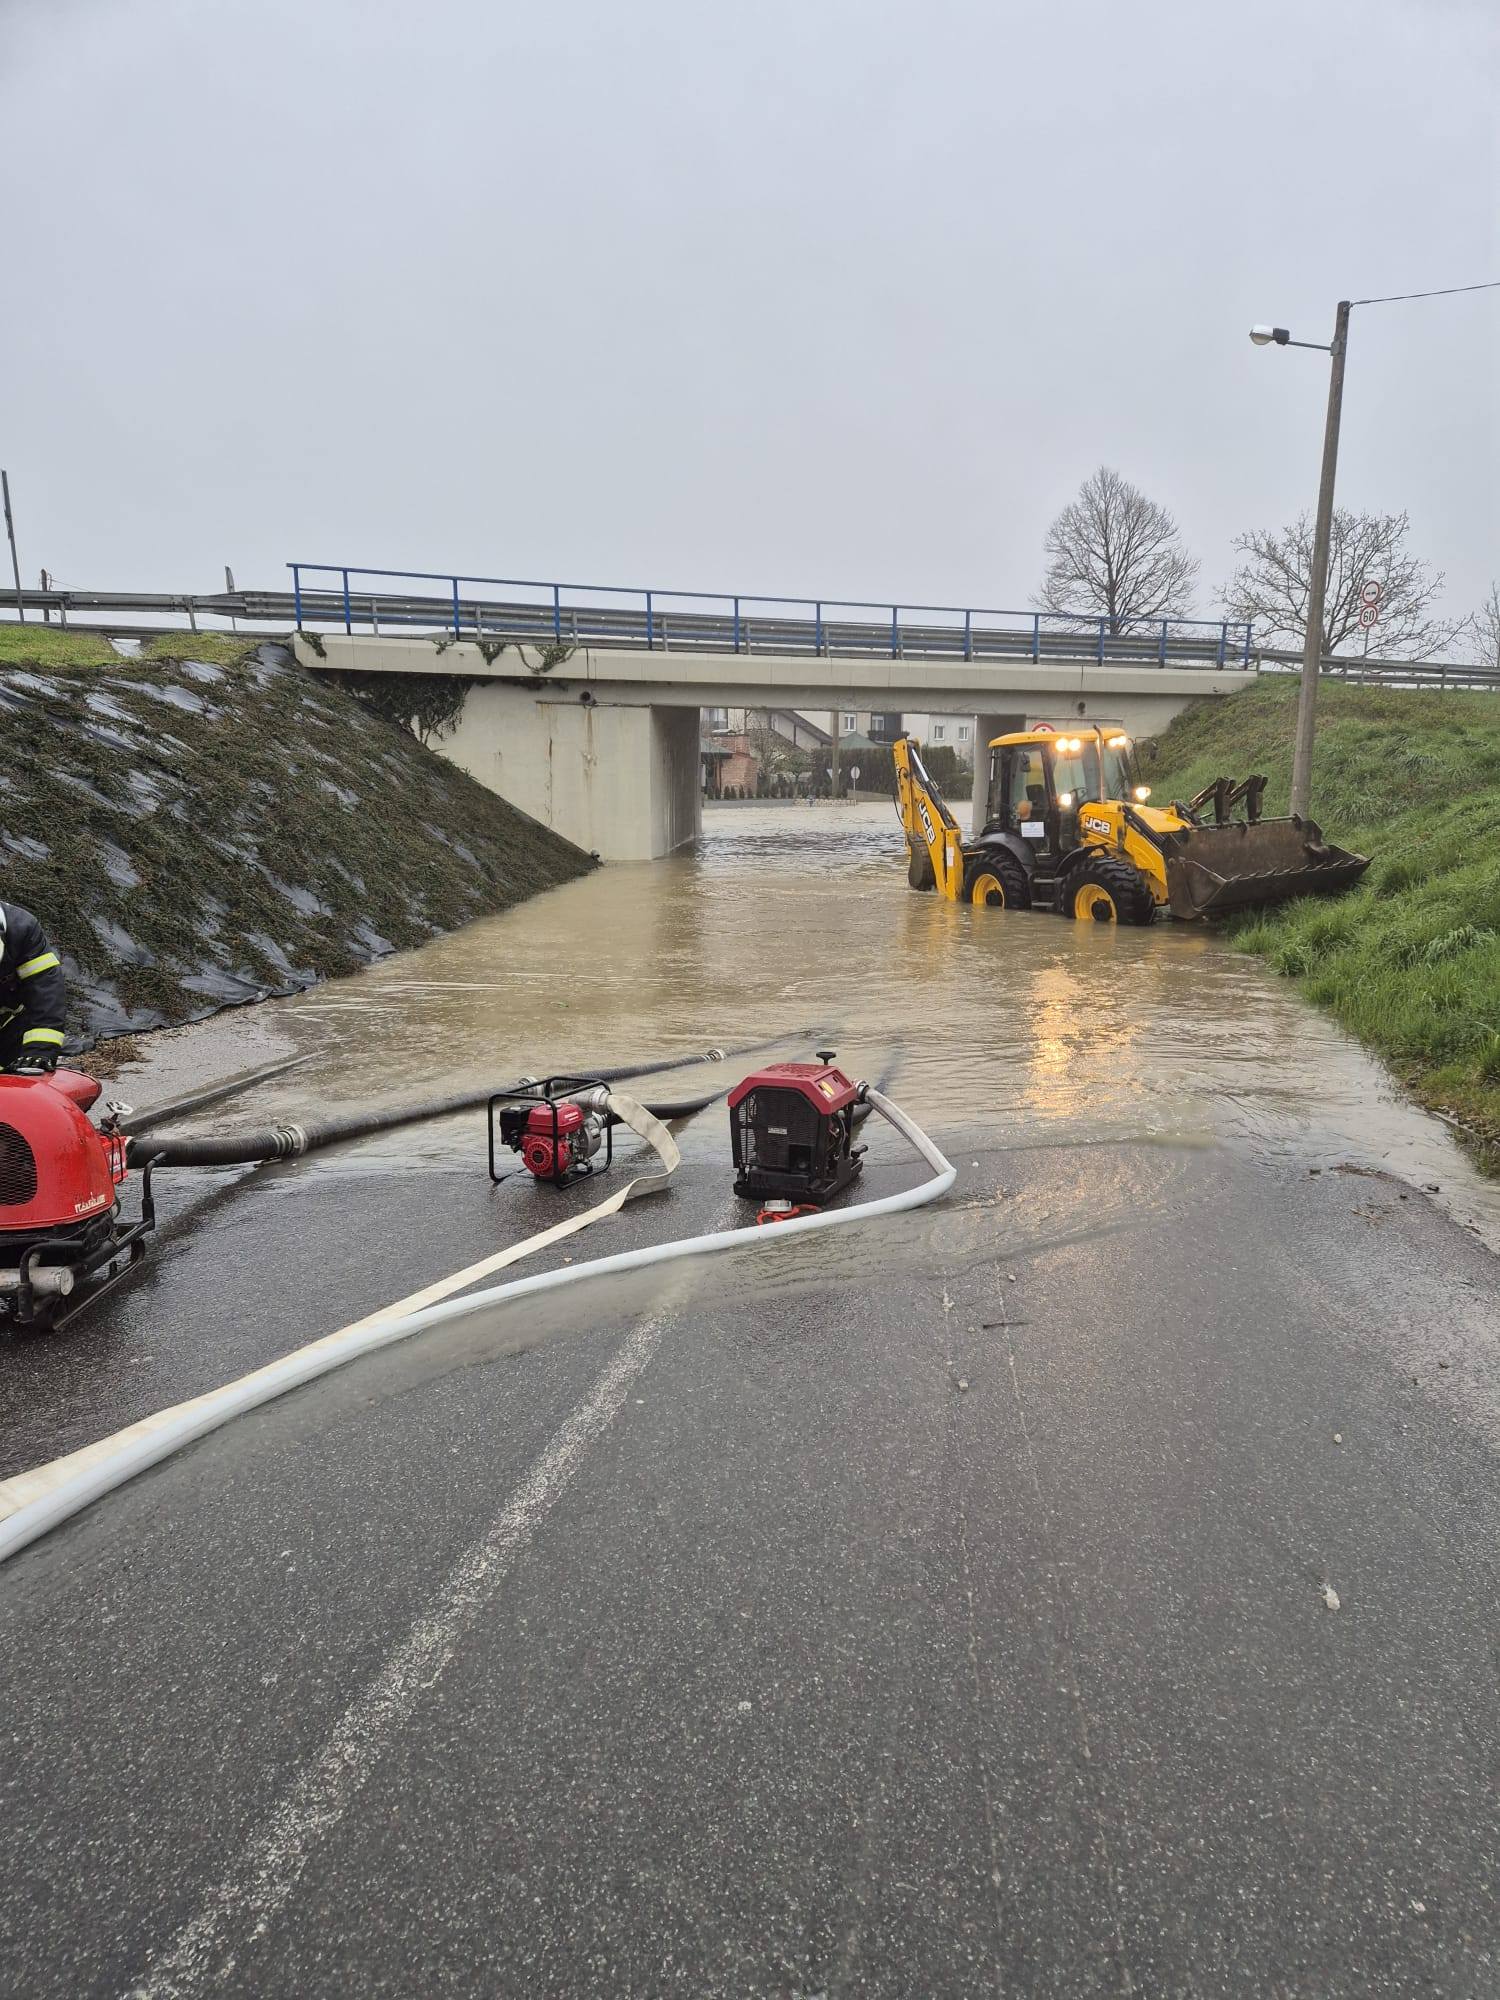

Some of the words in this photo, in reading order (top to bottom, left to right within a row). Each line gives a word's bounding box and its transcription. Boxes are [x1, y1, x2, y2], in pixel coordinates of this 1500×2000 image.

[1363, 610, 1375, 623] 60
[918, 802, 936, 845] JCB
[1085, 816, 1111, 834] JCB
